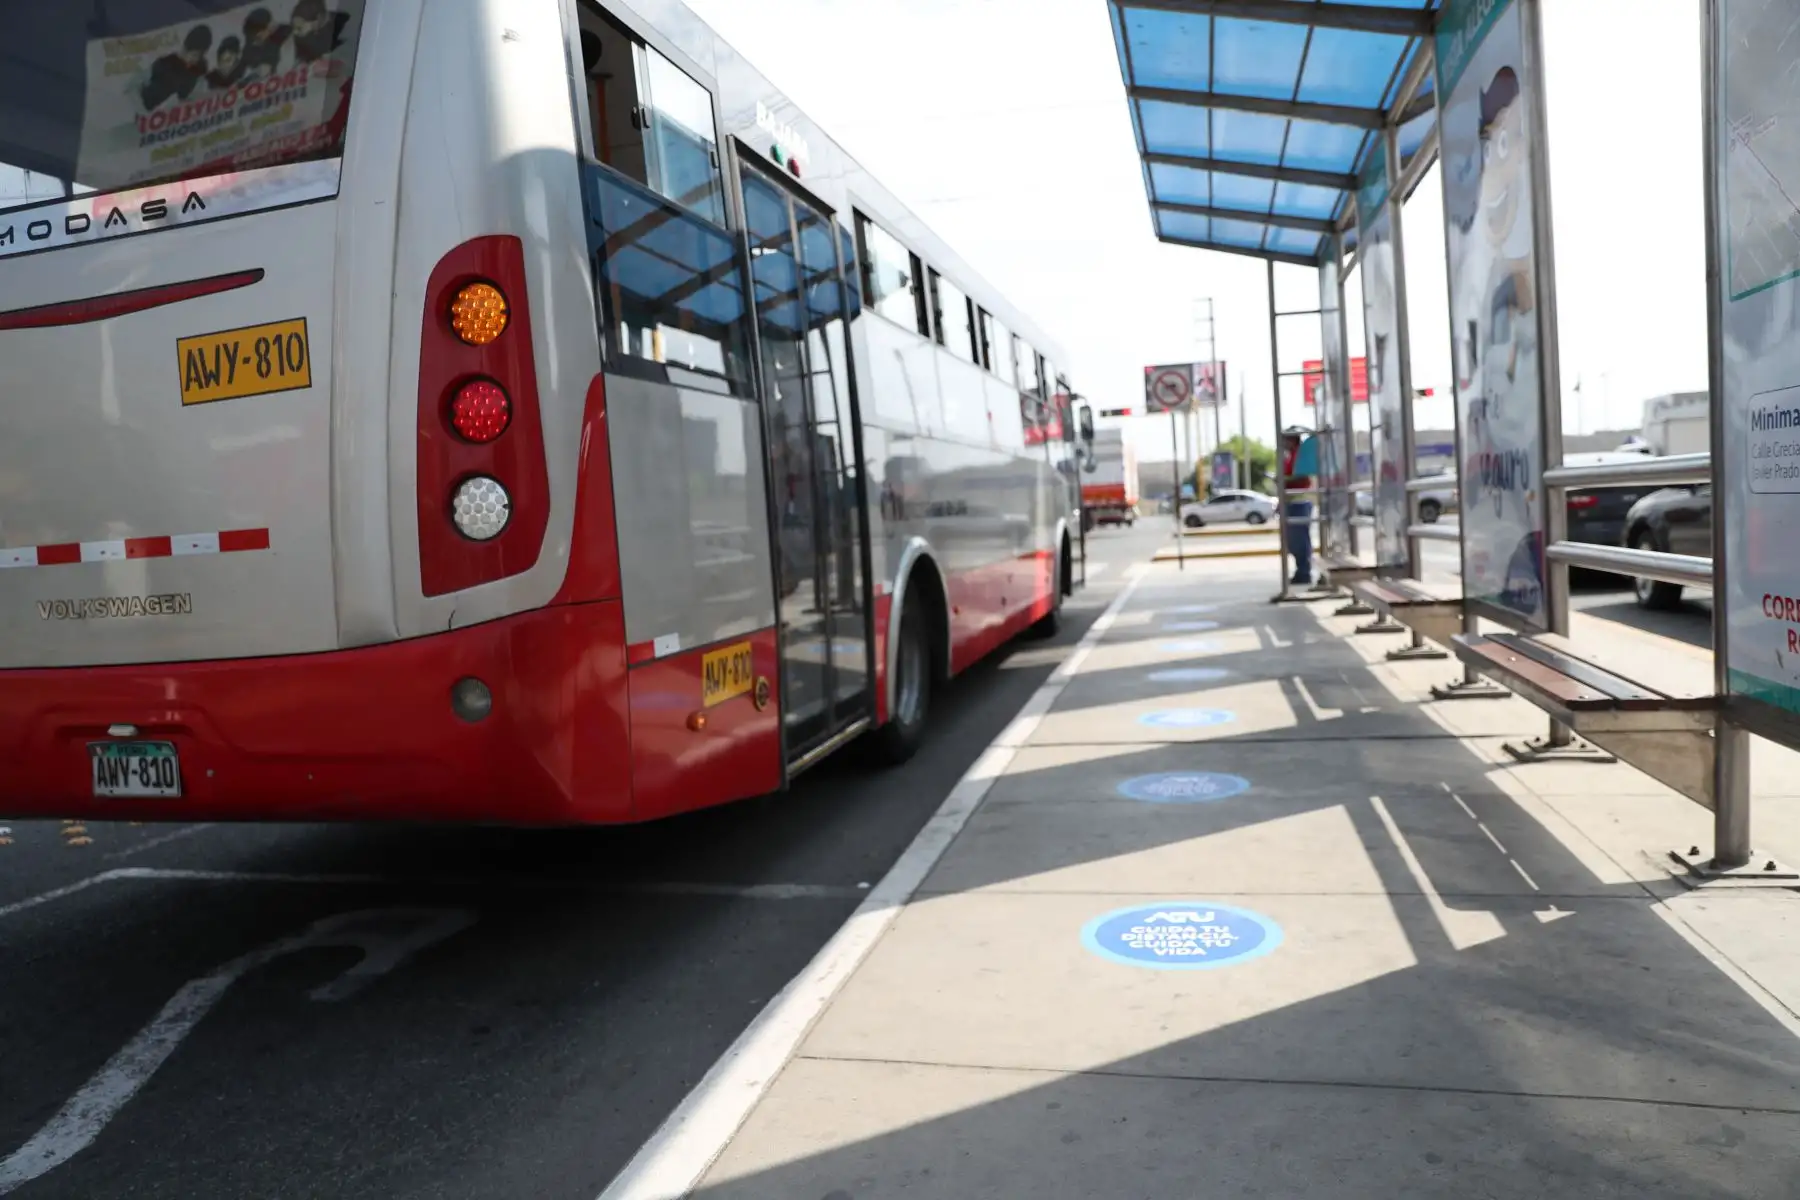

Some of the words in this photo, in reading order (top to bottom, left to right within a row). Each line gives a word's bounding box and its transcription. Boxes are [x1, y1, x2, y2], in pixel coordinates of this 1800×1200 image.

[184, 331, 305, 392] AWY-810
[1774, 461, 1800, 479] Prado
[36, 592, 192, 620] VOLKSWAGEN
[97, 757, 175, 788] AWY-810
[1130, 925, 1197, 933] CUIDA
[1200, 925, 1230, 933] TU
[1129, 940, 1198, 948] CUIDA
[1200, 940, 1231, 948] TU
[1153, 947, 1207, 956] VIDA
